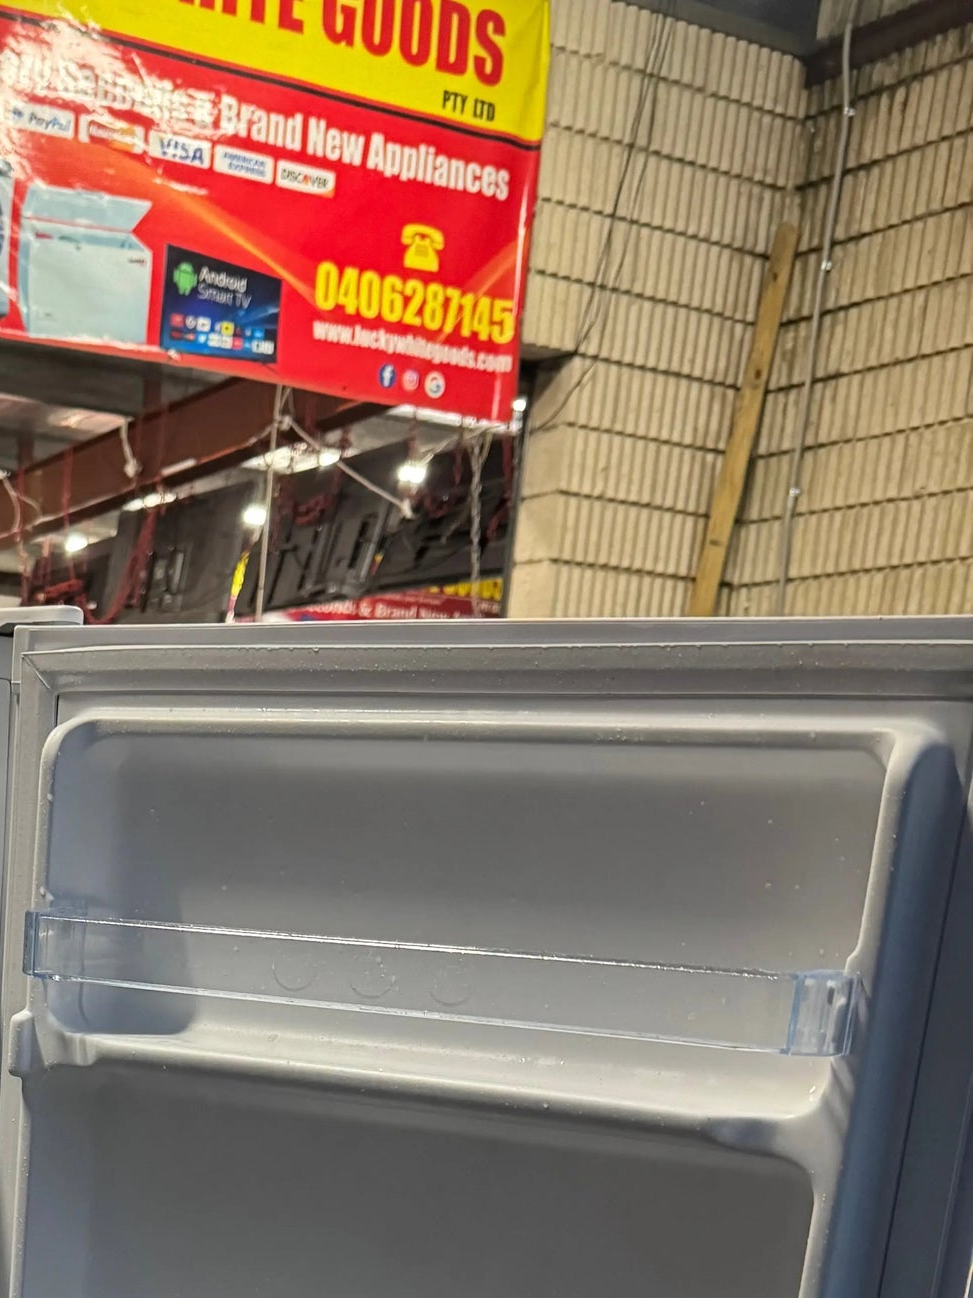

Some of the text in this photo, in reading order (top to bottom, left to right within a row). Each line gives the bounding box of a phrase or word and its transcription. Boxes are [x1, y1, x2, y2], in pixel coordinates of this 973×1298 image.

[322, 0, 506, 87] GOODS
[443, 90, 496, 122] PTY LTD
[29, 112, 72, 133] PayPal
[159, 138, 205, 166] VISA
[220, 95, 303, 152] Brand
[307, 116, 365, 167] New
[366, 131, 510, 201] Appliances
[198, 265, 248, 293] Android
[197, 282, 252, 309] Smart TV
[314, 260, 516, 344] 0406287145
[312, 320, 513, 373] www.luckywhitegoods.com
